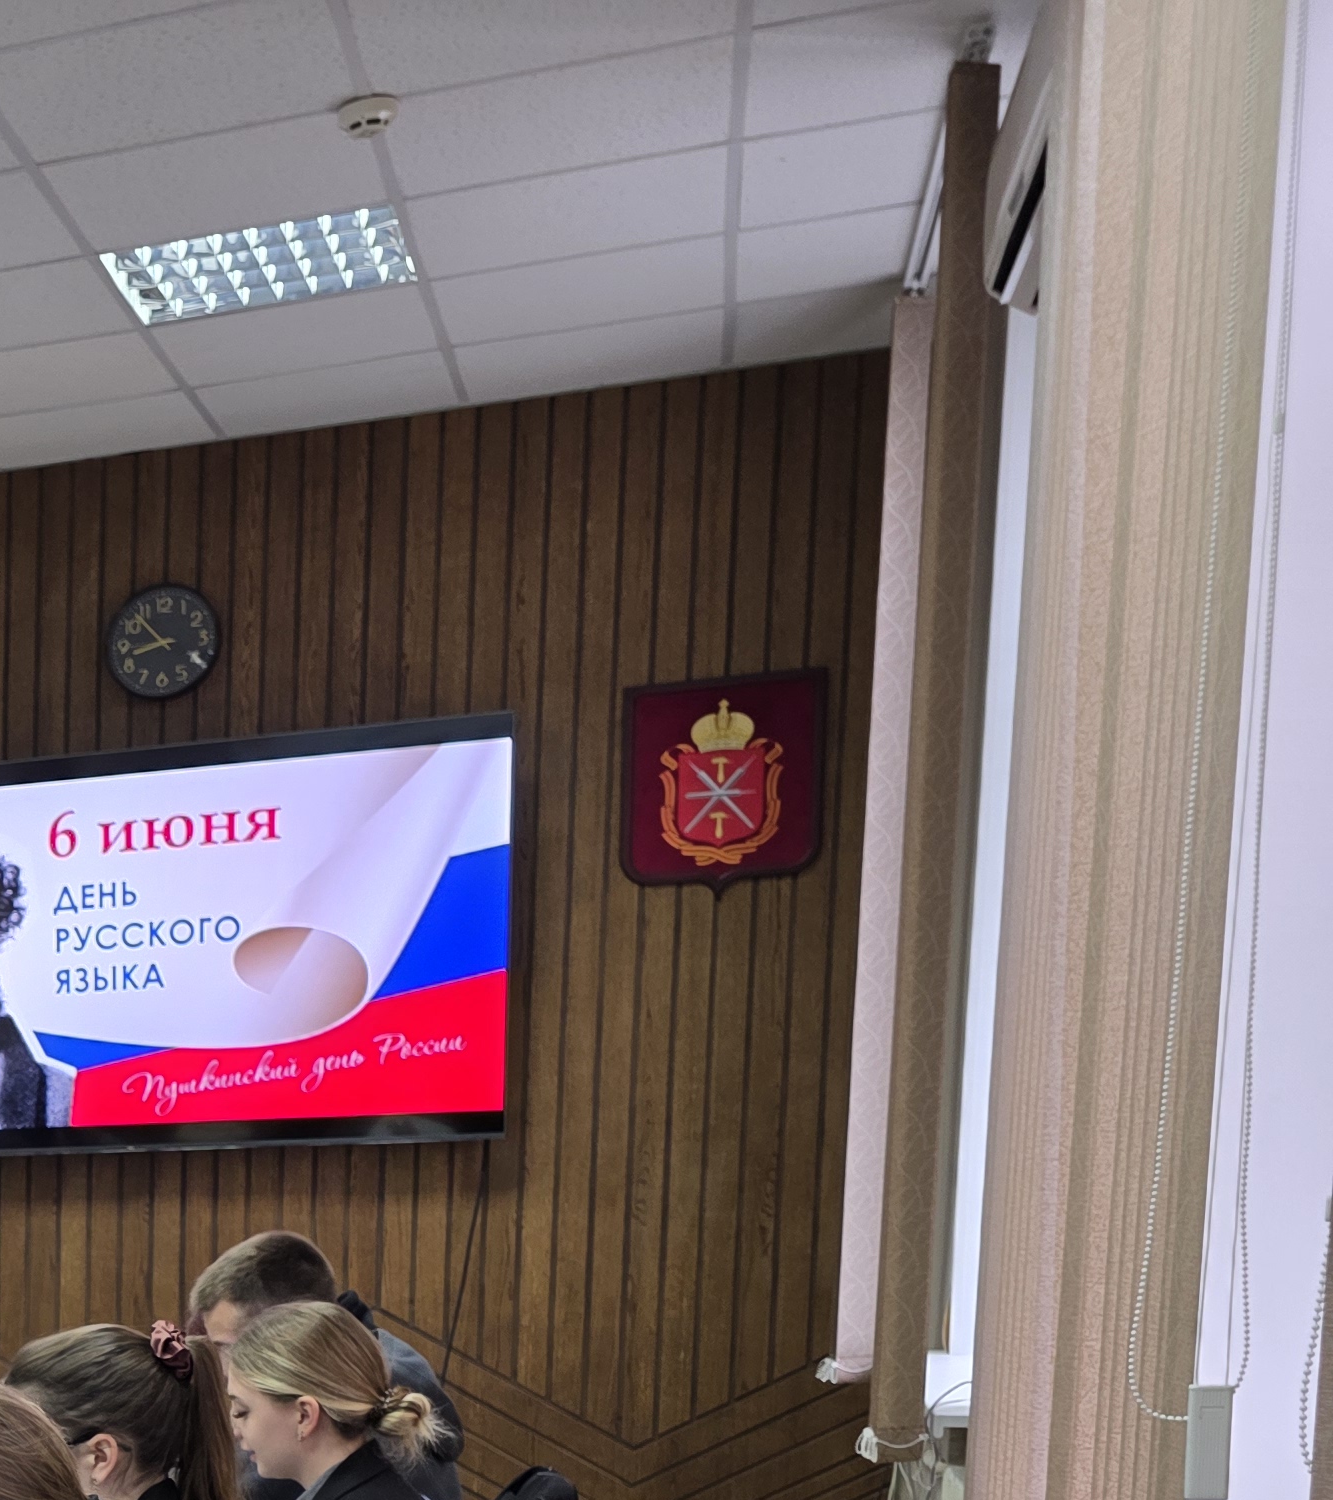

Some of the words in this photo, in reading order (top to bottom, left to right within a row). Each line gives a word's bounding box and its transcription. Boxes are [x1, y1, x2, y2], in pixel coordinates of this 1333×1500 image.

[156, 595, 174, 614] 12
[124, 618, 142, 635] 10
[190, 610, 203, 628] 2
[117, 638, 131, 655] 9
[139, 668, 150, 685] 7
[155, 671, 170, 688] 6
[175, 664, 189, 682] 5
[48, 810, 76, 858] 6
[97, 806, 282, 854] июня
[53, 881, 137, 916] ДЕНЬ
[56, 915, 240, 953] РУССКОГО
[56, 963, 165, 994] ЯЗЫКА
[121, 1049, 301, 1117] Пушкинский
[301, 1050, 366, 1093] день
[372, 1032, 468, 1065] России
